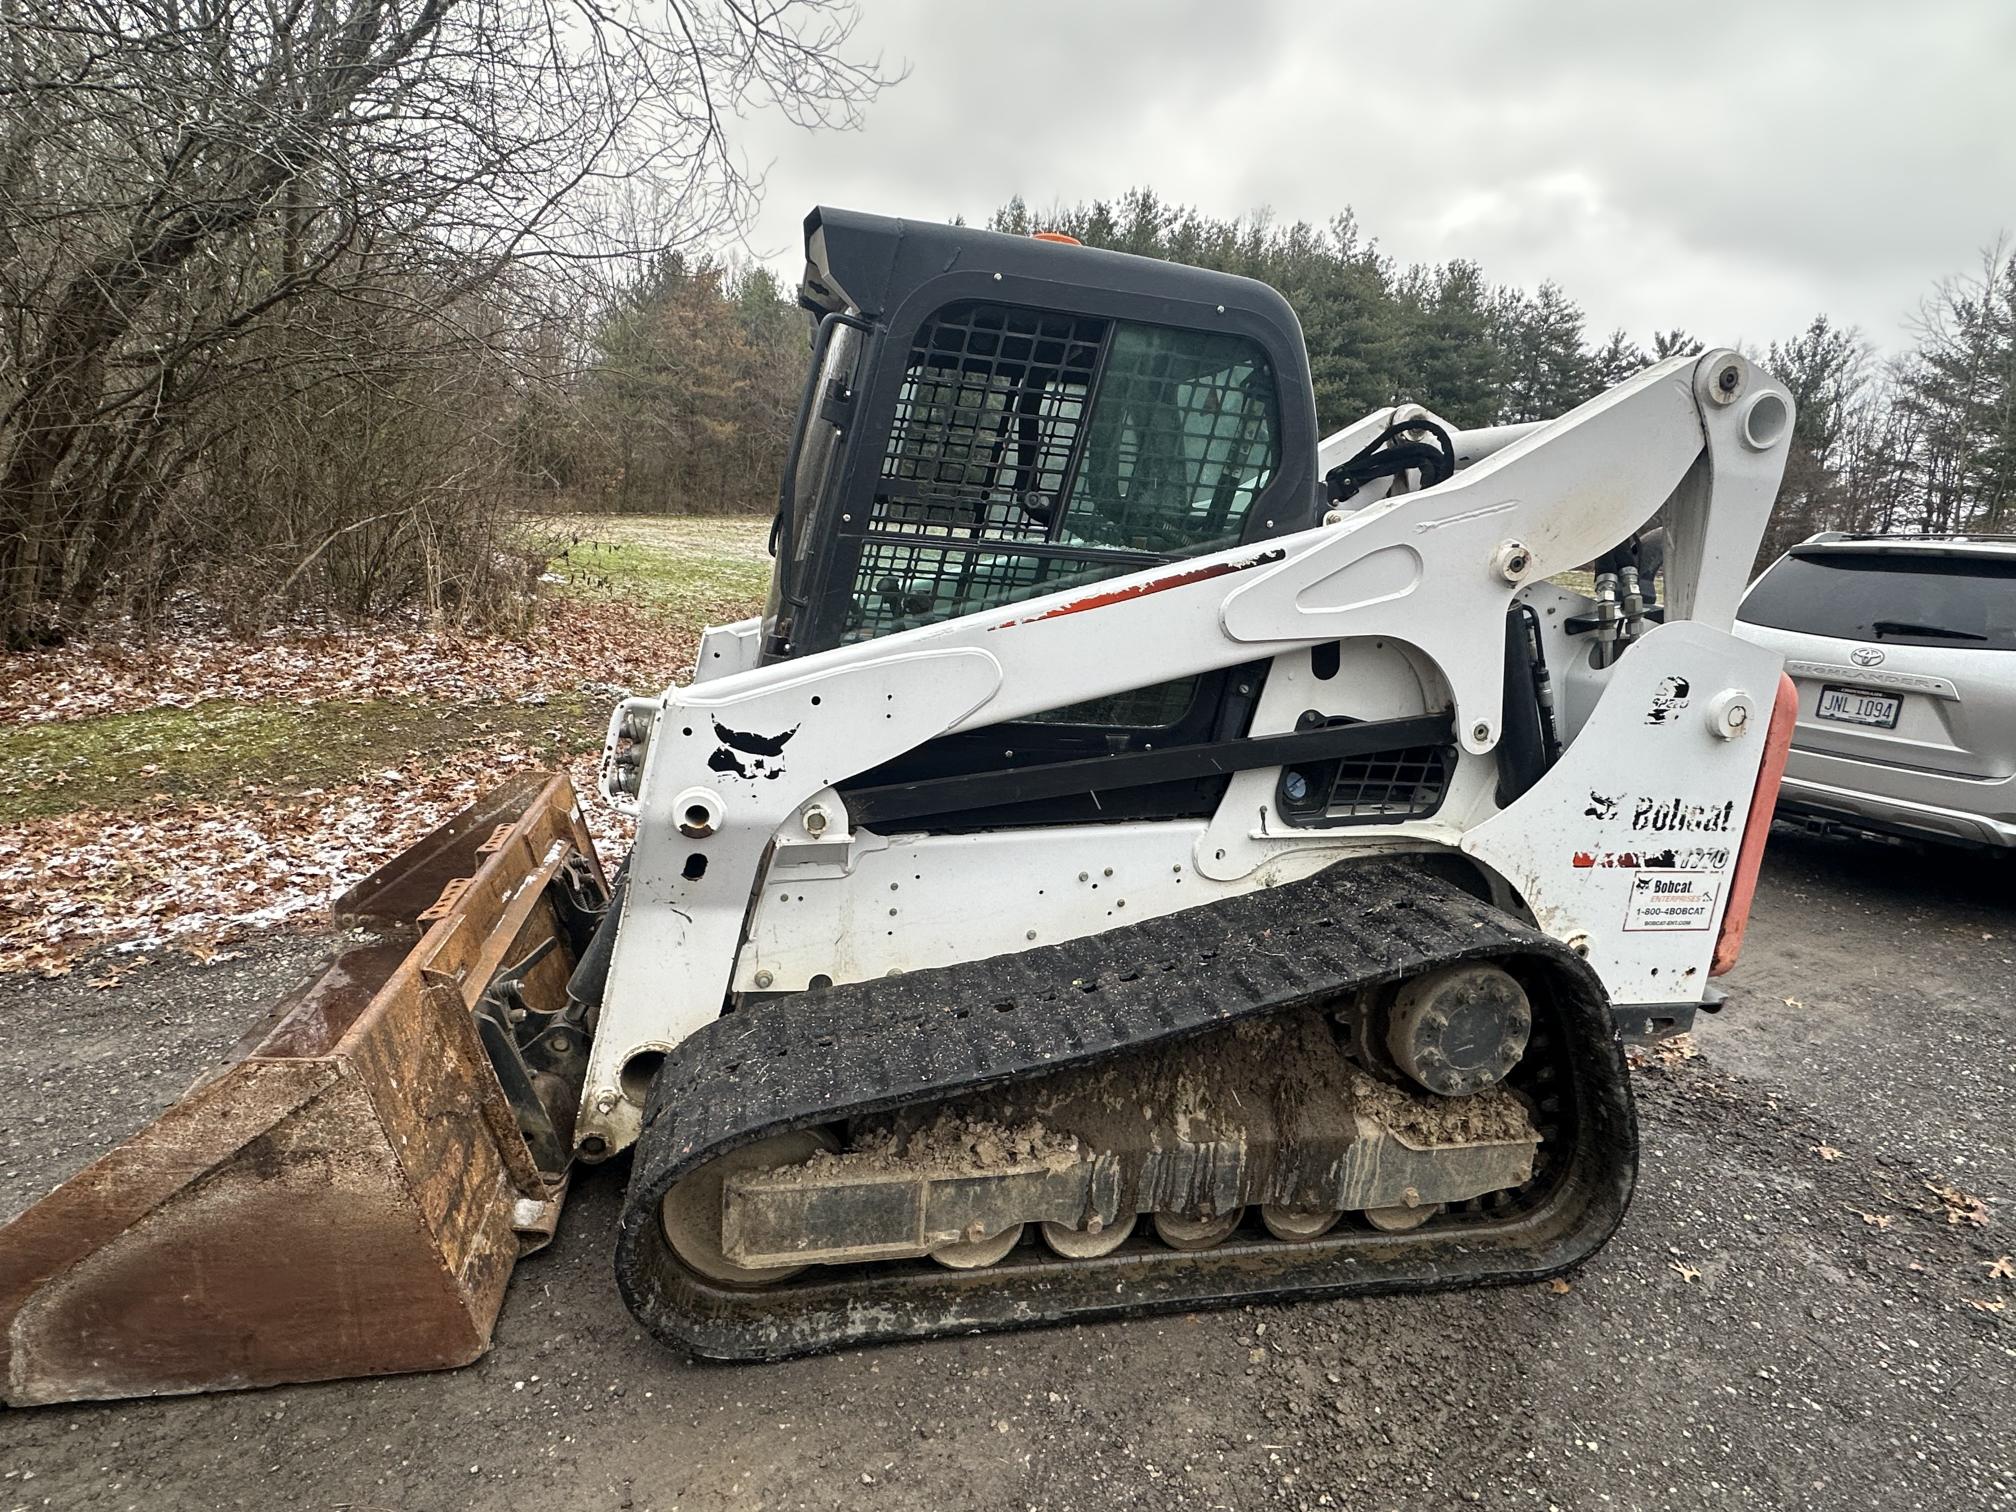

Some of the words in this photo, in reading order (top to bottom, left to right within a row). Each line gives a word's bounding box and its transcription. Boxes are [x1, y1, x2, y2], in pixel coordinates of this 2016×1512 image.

[1792, 664, 1930, 688] HIGHLANDER
[1824, 694, 1849, 713] JNL
[1855, 699, 1893, 719] 1094
[1653, 880, 1693, 894] Bobcat
[1650, 895, 1702, 903] ENTERPRISES
[1636, 907, 1706, 916] 1-800-4BOBCAT
